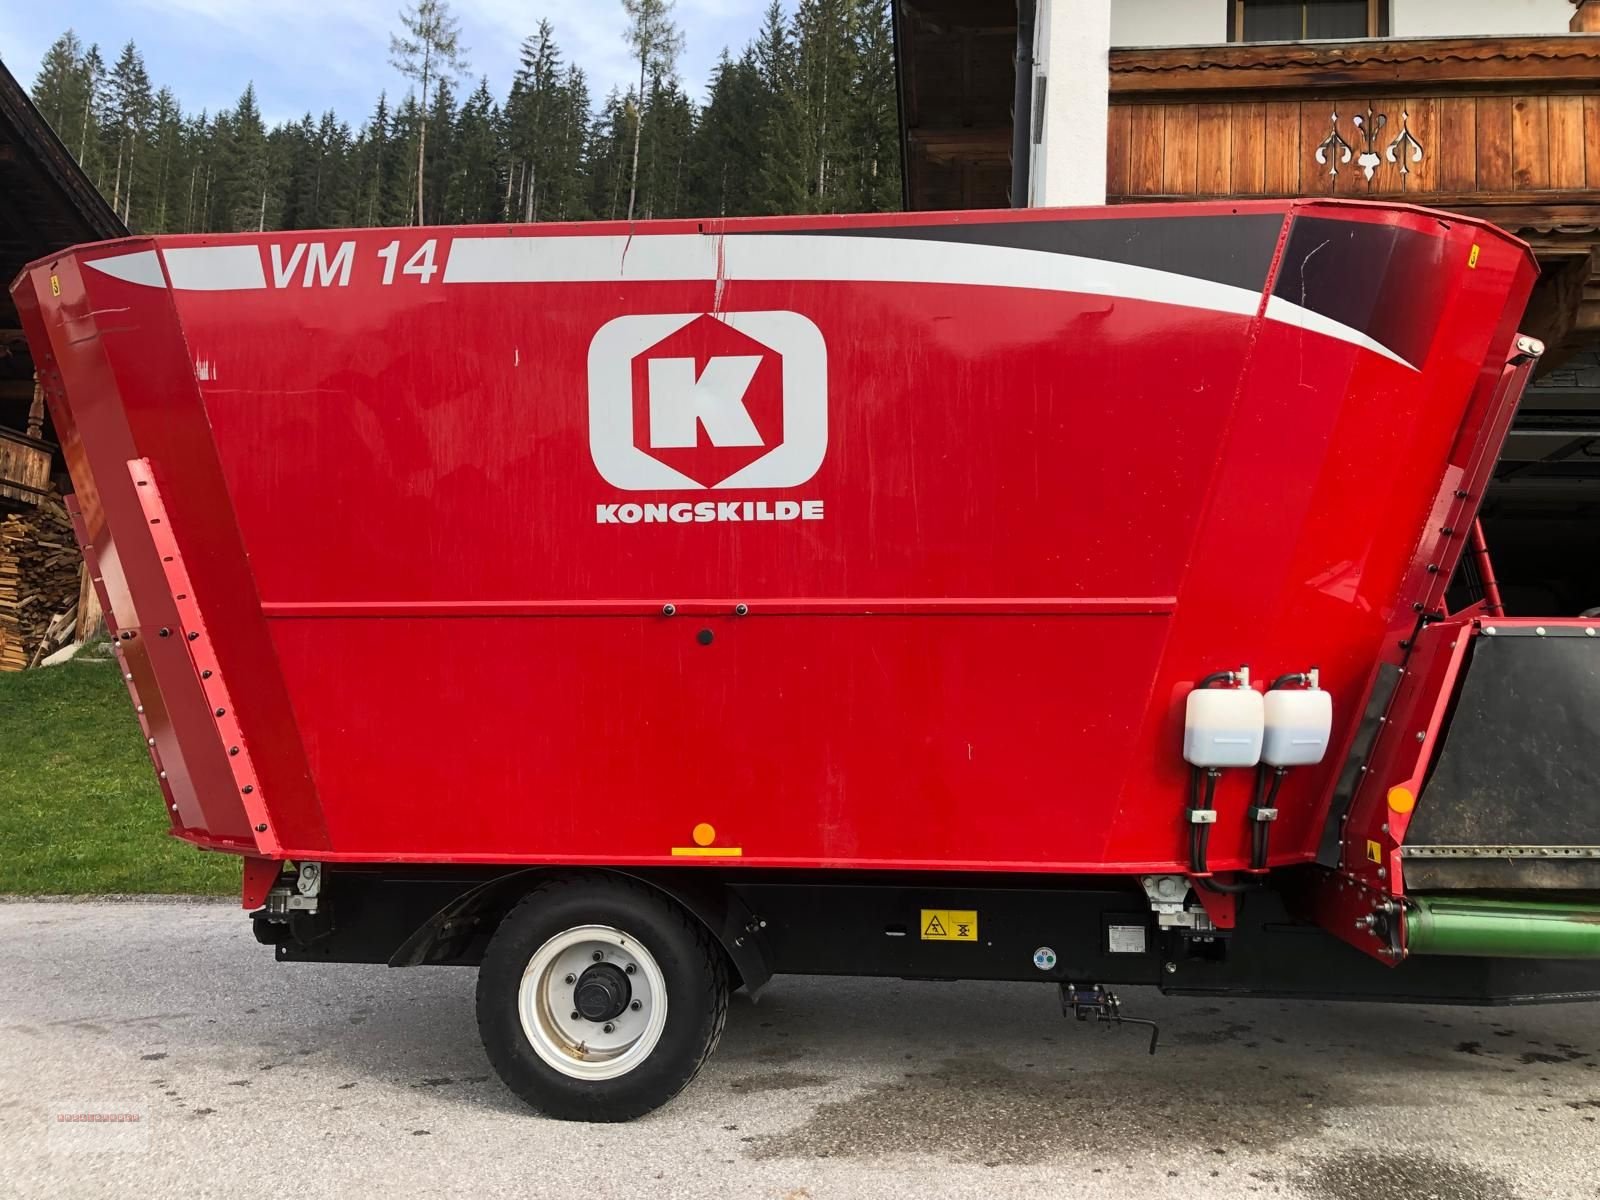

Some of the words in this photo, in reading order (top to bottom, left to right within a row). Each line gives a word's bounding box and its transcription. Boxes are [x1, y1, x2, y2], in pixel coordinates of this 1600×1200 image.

[270, 241, 357, 289] VM
[377, 239, 438, 285] 14
[648, 355, 765, 448] K
[596, 500, 824, 523] KONGSKILDE
